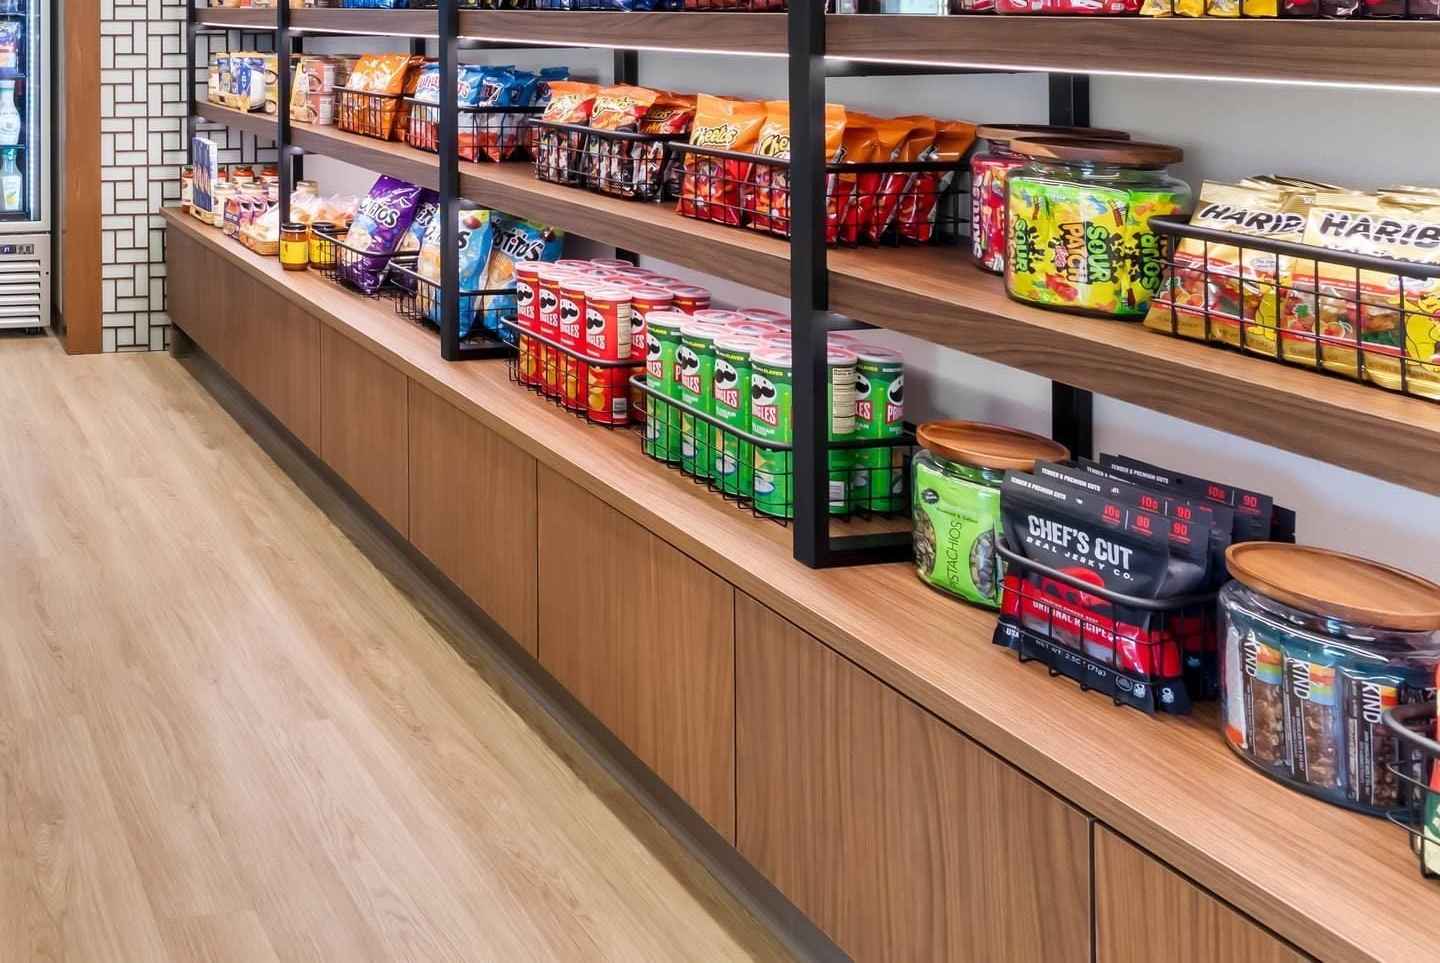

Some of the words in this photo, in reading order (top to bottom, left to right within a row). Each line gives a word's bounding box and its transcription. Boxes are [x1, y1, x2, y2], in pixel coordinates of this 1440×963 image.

[1200, 203, 1306, 234] HARIB
[1061, 222, 1088, 284] PATCH
[1087, 226, 1111, 283] SOUR
[1176, 506, 1192, 520] 90
[1242, 494, 1258, 508] 90
[1136, 515, 1151, 529] 90
[1173, 522, 1188, 536] 90
[1025, 536, 1058, 554] REAL
[1063, 550, 1106, 570] JERKY
[1113, 568, 1135, 582] CO.
[1027, 515, 1091, 557] CHEF'S
[1094, 537, 1134, 571] CUT
[1292, 660, 1311, 700] KIND
[1361, 681, 1383, 724] KIND
